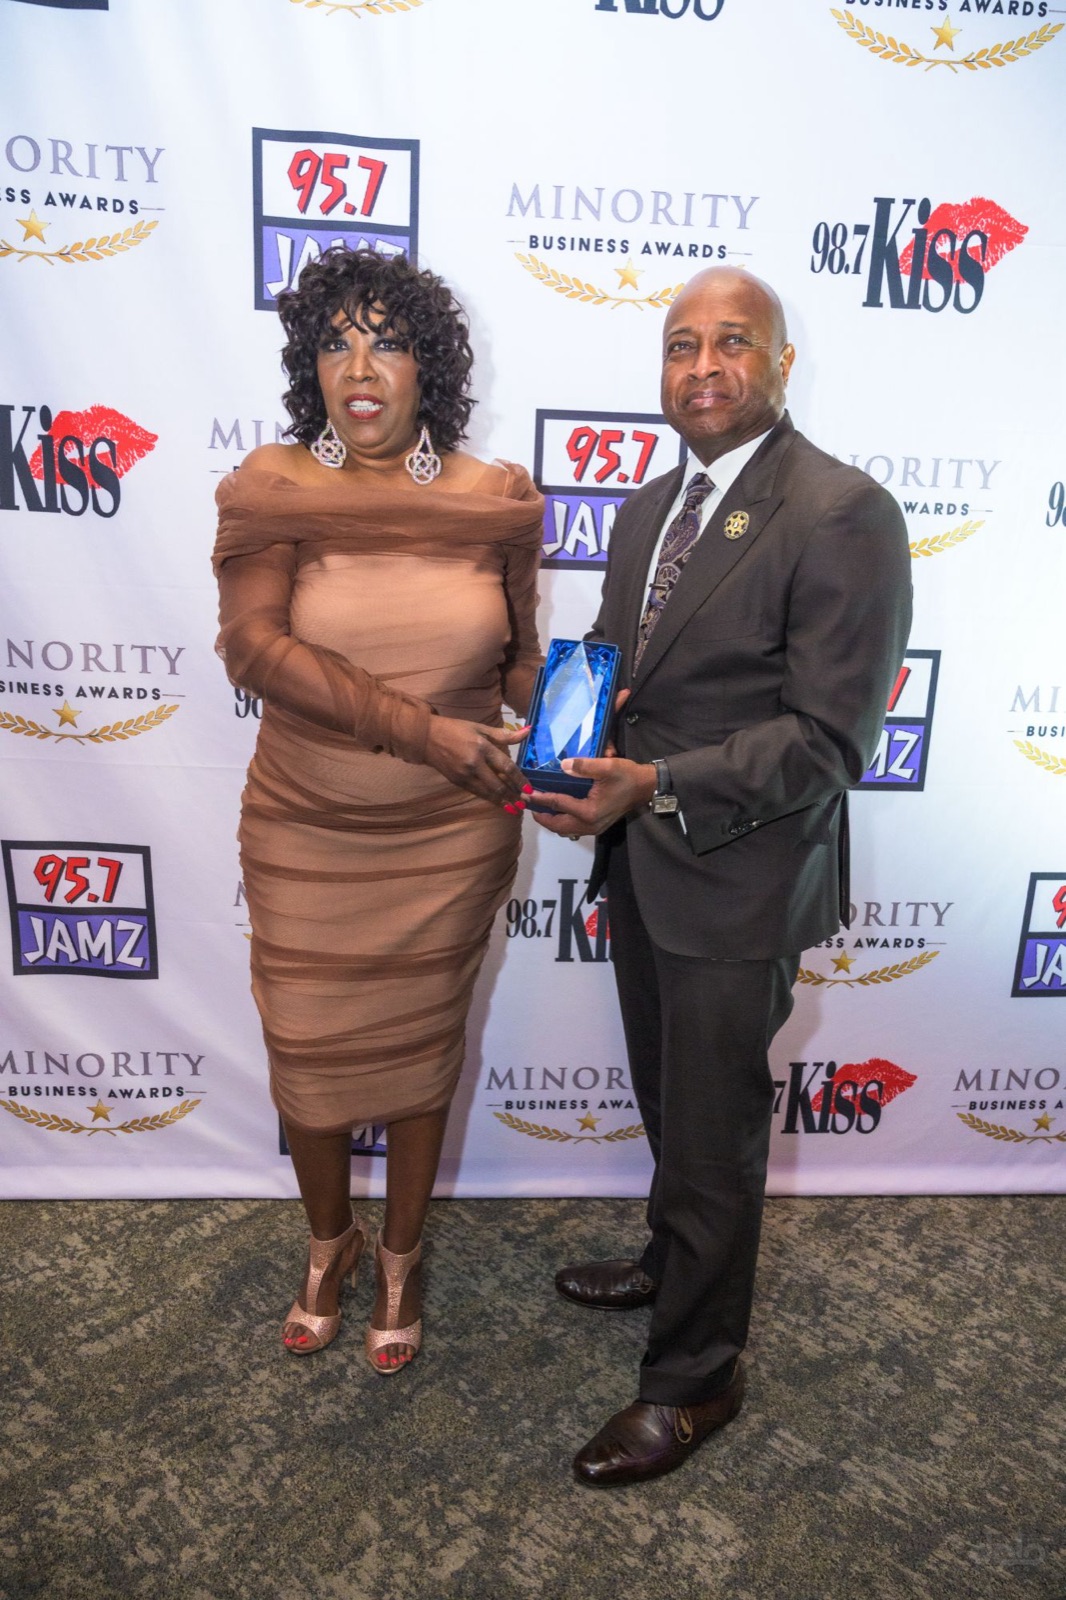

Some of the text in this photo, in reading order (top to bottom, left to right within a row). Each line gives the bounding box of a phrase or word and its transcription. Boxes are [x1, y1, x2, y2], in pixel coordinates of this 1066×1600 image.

[959, 0, 1048, 17] AWARDS
[287, 149, 388, 217] 95.7
[0, 187, 139, 215] SS AWARDS
[505, 182, 760, 230] MINORITY
[529, 235, 727, 259] BUSINESS AWARDS
[810, 197, 988, 314] 98.7 Kiss
[0, 404, 121, 518] Kiss
[566, 426, 659, 484] 95.7
[75, 685, 161, 700] AWARDS
[1008, 685, 1066, 713] MI
[33, 854, 123, 904] 95.7
[506, 898, 557, 938] 98.7
[23, 916, 146, 968] JAMZ
[853, 938, 926, 948] AWARDS
[8, 1086, 184, 1099] BUSINESS AWARDS
[485, 1067, 634, 1090] MINOR
[953, 1068, 1066, 1091] MINO
[505, 1100, 588, 1110] BUSINESS
[781, 1061, 885, 1134] Kiss
[969, 1100, 1046, 1110] BUSINESS
